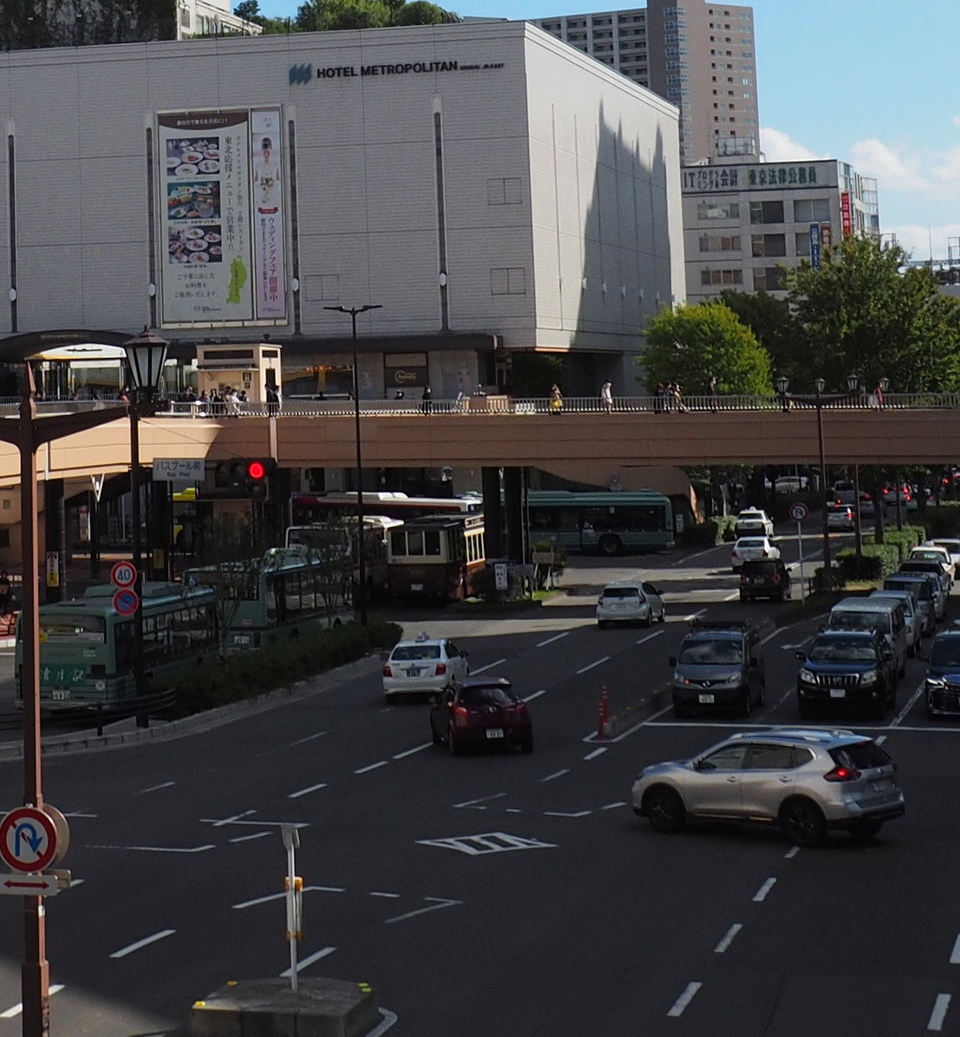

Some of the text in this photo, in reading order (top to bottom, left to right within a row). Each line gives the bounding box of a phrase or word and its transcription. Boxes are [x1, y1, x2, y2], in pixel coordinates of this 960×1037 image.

[317, 66, 358, 79] HOTEL
[360, 61, 458, 77] METROPOLITAN
[747, 166, 817, 187] 東京法律公務員
[117, 569, 131, 581] 40
